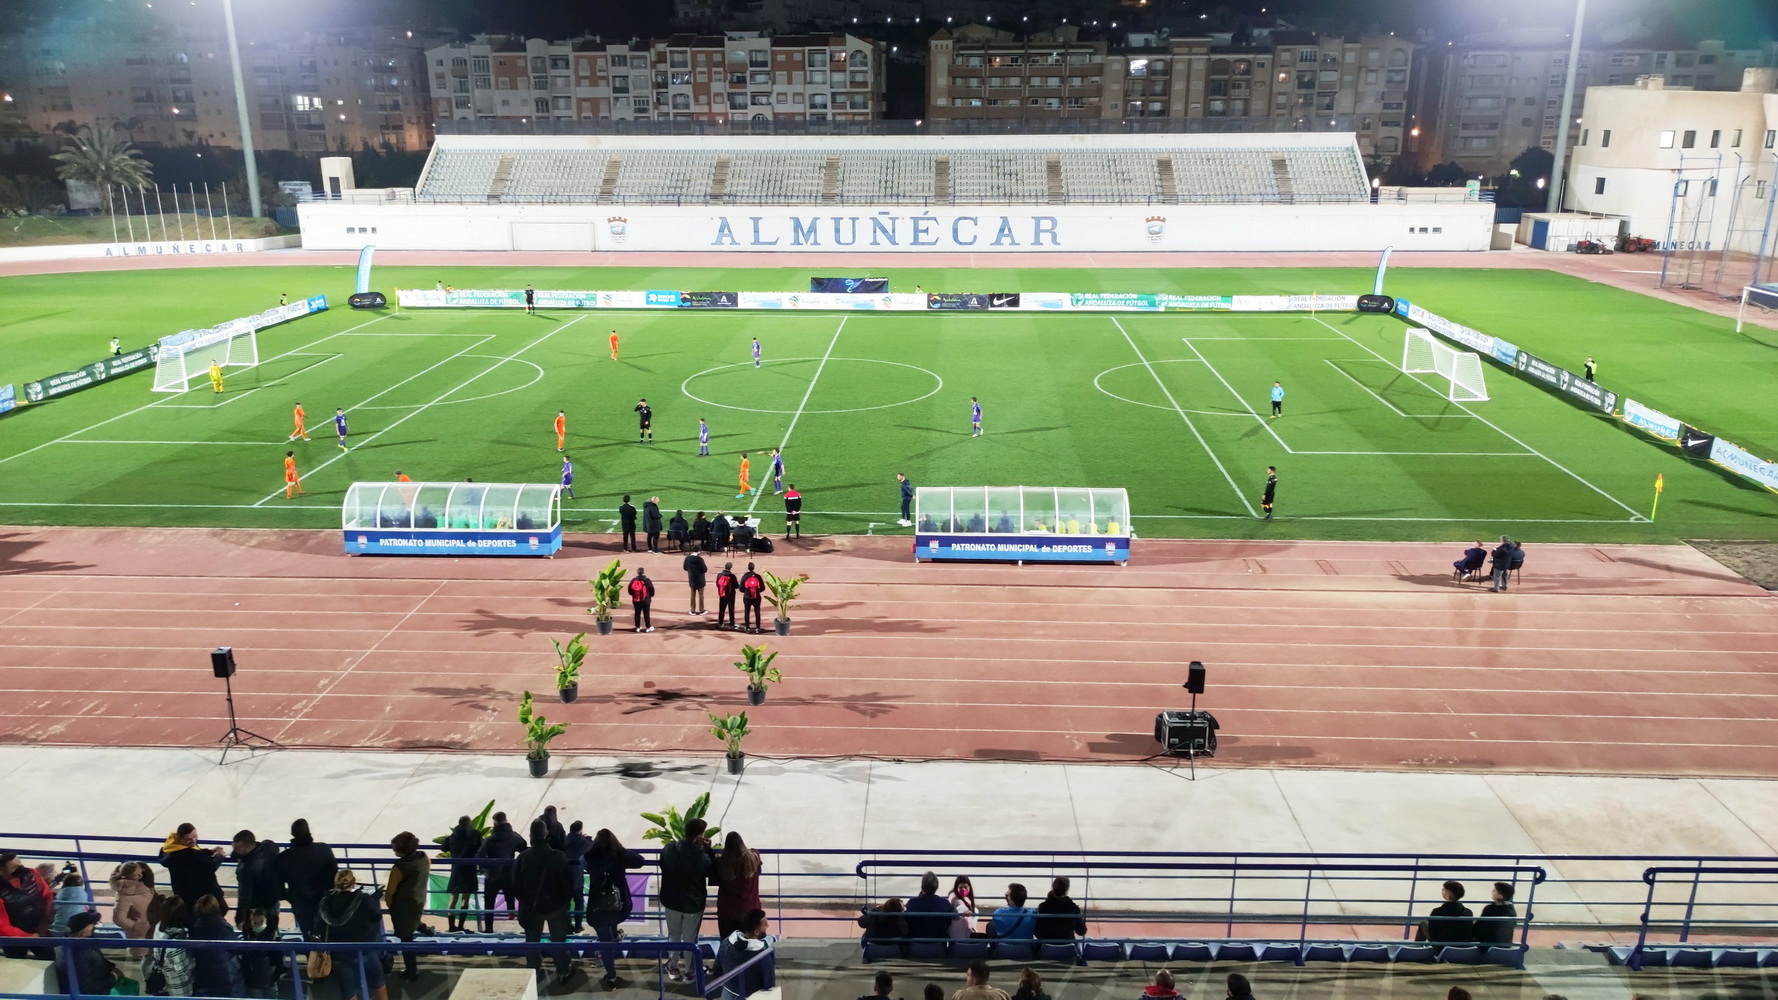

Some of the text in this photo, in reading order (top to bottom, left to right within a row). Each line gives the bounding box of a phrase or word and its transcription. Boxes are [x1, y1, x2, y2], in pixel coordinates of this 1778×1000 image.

[711, 211, 1061, 246] ALMUÑÉCAR
[380, 538, 517, 548] PATRONATO MUNICIPAL de DEPORTES
[951, 543, 996, 552] PATRONATO
[998, 544, 1039, 552] MUNICIPAL
[1052, 544, 1092, 553] DEPORTES
